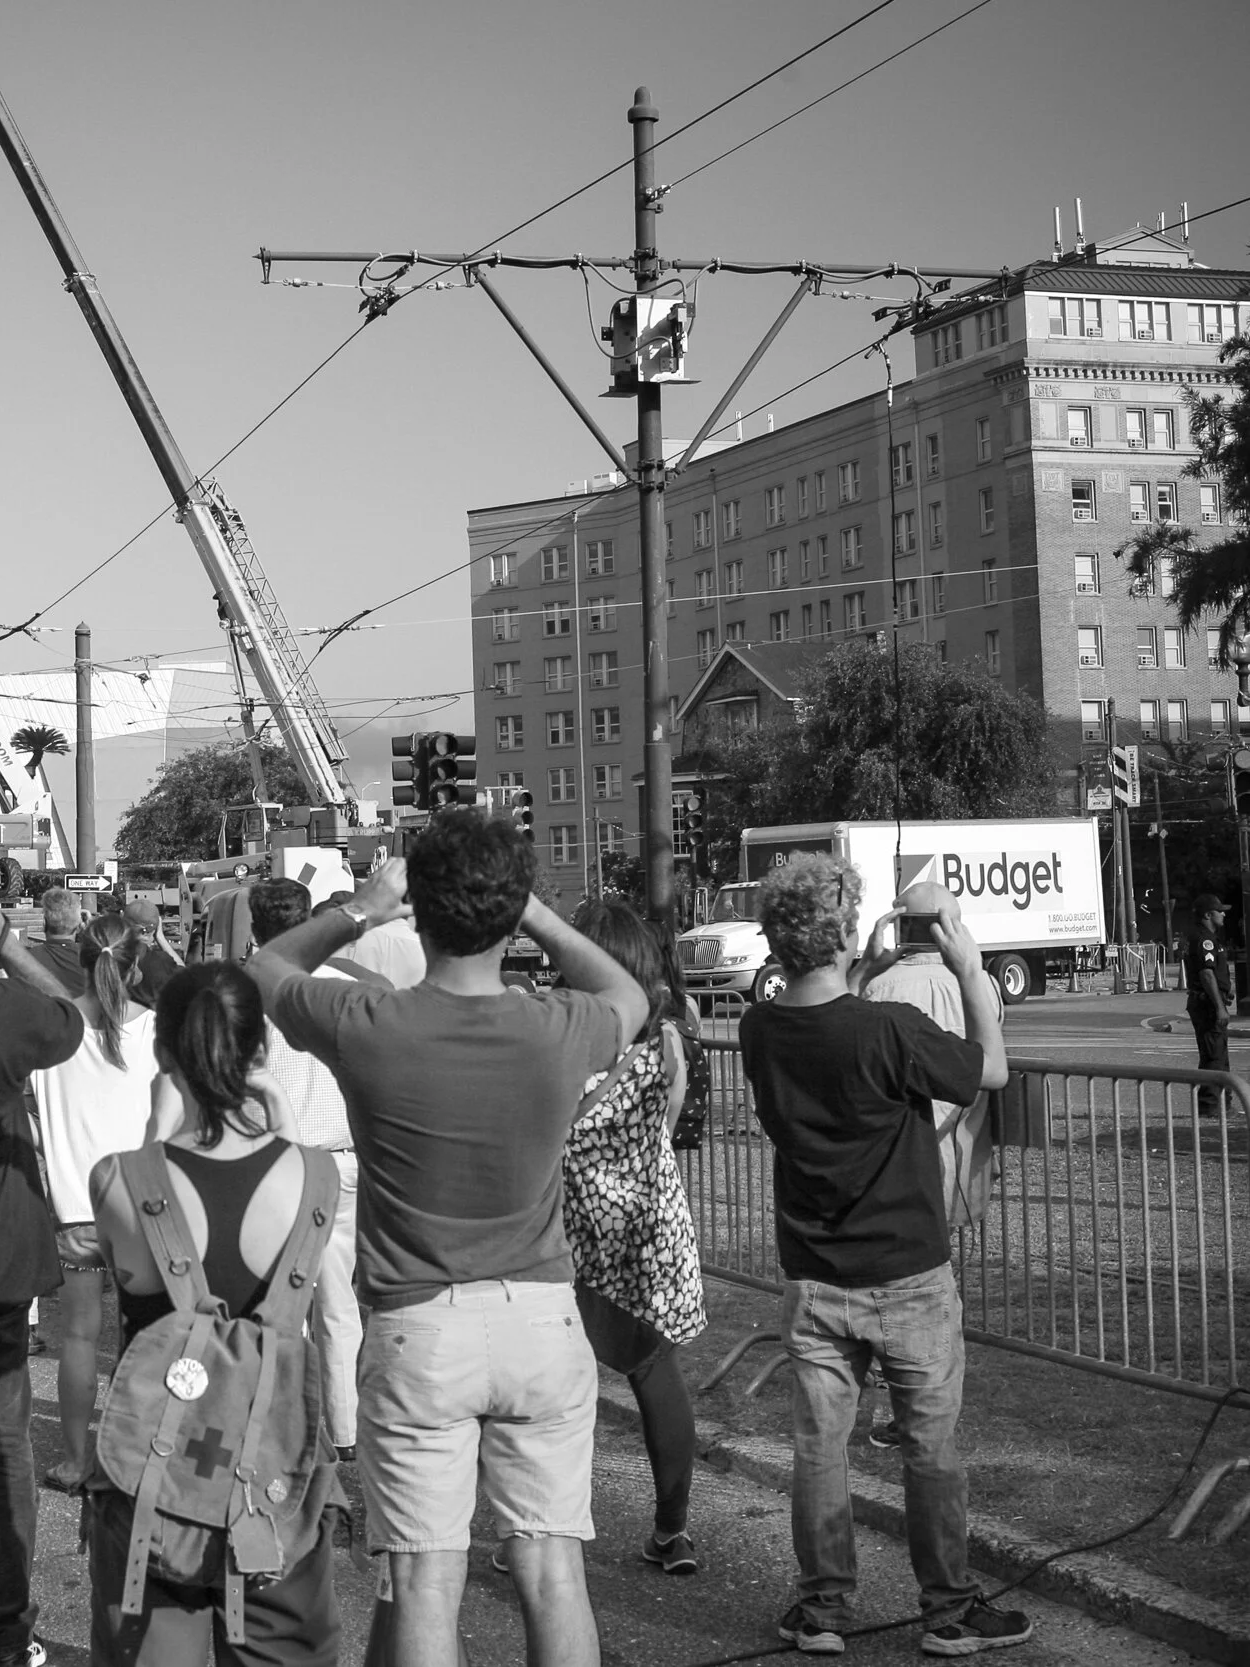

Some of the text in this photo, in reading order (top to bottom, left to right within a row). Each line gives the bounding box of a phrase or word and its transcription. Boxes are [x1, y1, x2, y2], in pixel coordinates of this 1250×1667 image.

[70, 879, 83, 887] ONE
[942, 851, 1063, 910] Budget
[1048, 924, 1098, 933] www.budget.com
